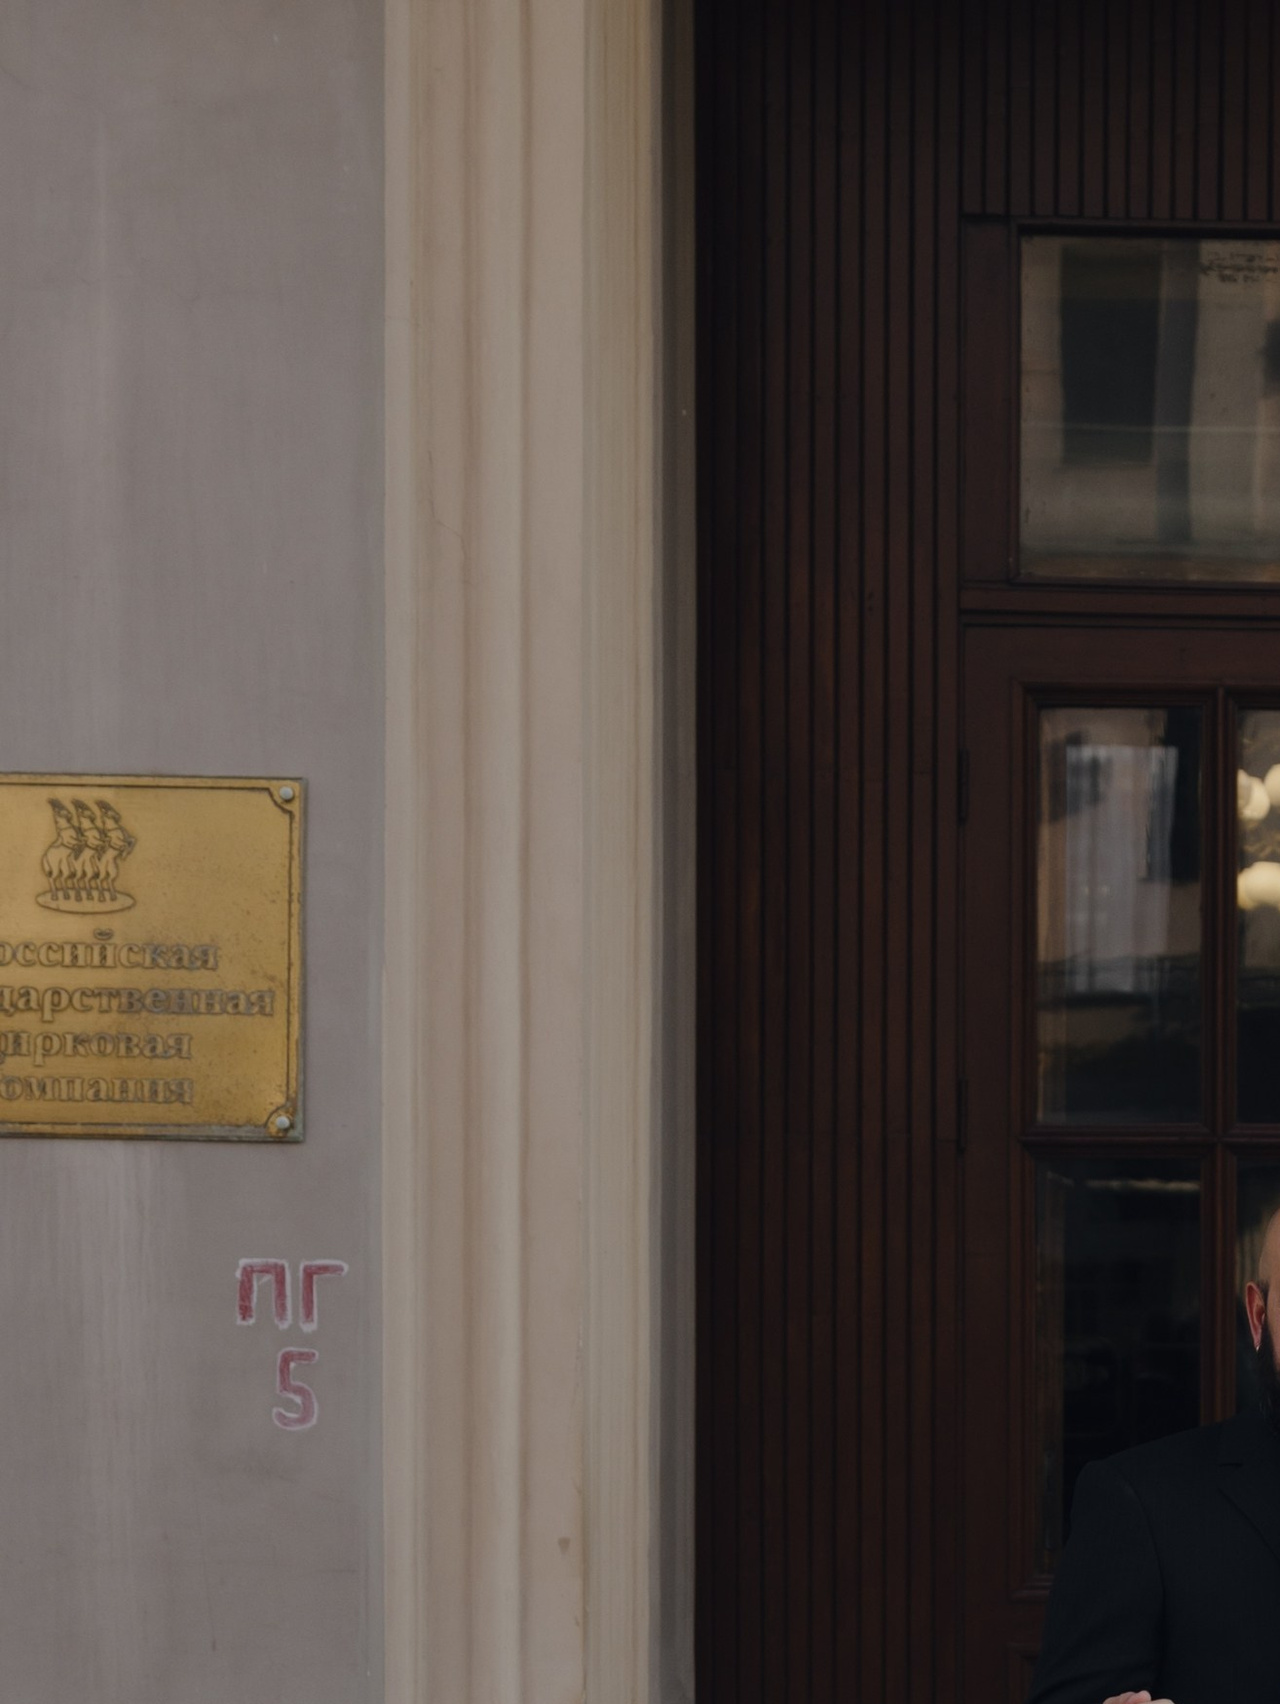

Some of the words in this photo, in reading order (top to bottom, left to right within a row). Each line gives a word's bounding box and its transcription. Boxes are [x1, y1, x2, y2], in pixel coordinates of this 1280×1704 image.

[0, 1030, 194, 1068] ирковая
[235, 1257, 349, 1333] ПГ
[272, 1346, 319, 1431] 5
